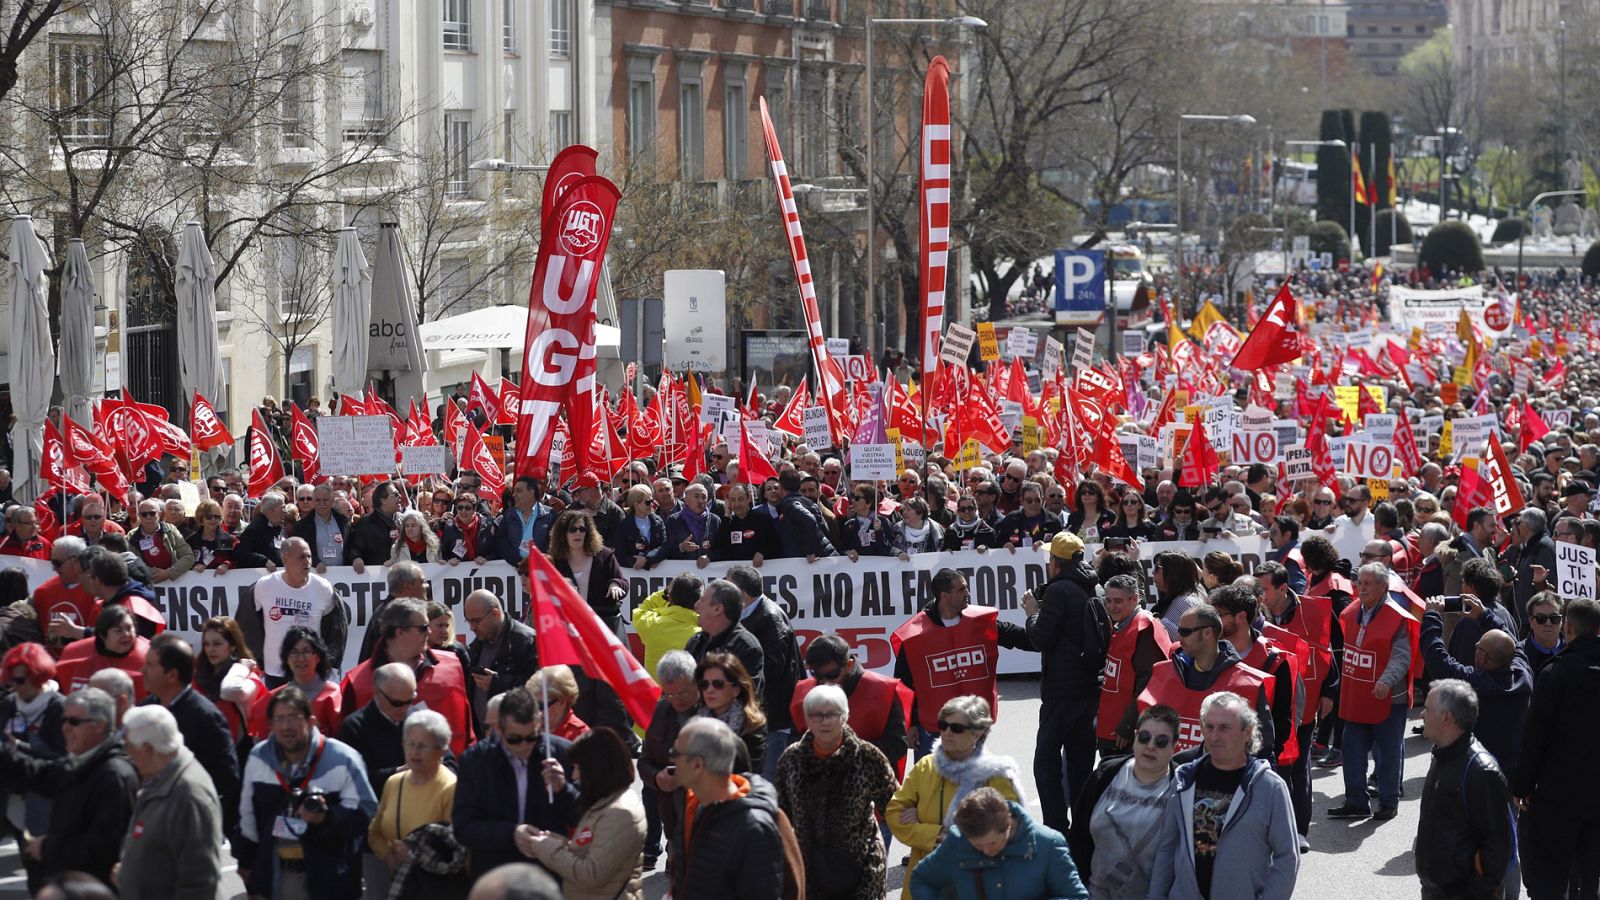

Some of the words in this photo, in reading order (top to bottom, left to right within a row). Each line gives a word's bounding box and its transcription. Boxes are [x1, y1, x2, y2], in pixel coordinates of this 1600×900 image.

[566, 209, 600, 235] UGT
[1064, 254, 1095, 300] P
[1078, 290, 1096, 300] 24h
[521, 255, 595, 458] UGT
[1207, 410, 1227, 424] JUS-
[1543, 411, 1569, 429] NO
[1211, 425, 1222, 436] TI-
[807, 437, 819, 448] POR
[1233, 432, 1276, 463] NO
[1346, 442, 1392, 478] NO
[1559, 546, 1594, 565] JUS-
[1567, 565, 1587, 580] TI-
[813, 572, 853, 618] NO
[861, 571, 896, 617] AL
[1562, 580, 1592, 598] CIA!
[275, 597, 312, 611] HILFIGER
[931, 649, 985, 672] CCOO
